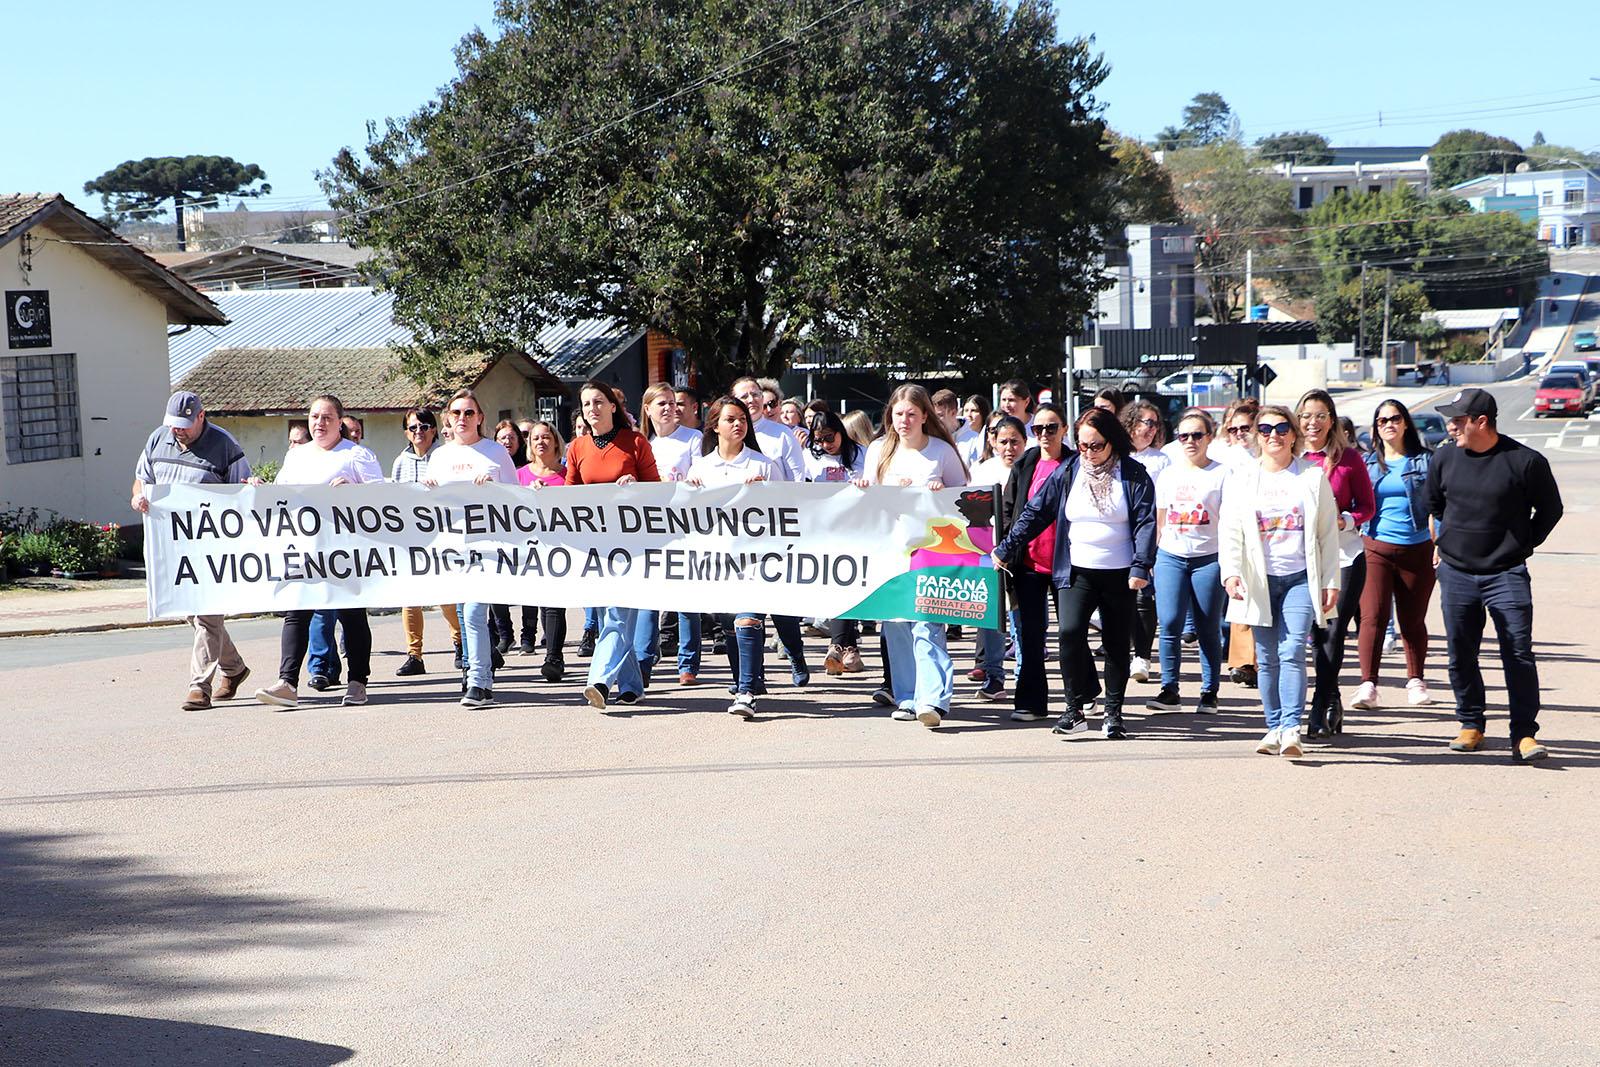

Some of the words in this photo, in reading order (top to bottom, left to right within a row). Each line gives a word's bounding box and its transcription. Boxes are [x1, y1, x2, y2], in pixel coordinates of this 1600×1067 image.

[170, 502, 244, 541] NÃO
[250, 499, 322, 537] VÃO
[331, 505, 405, 535] NOS
[412, 503, 607, 535] SILENCIAR!
[617, 505, 801, 538] DENUNCIE
[174, 555, 200, 586] A
[205, 543, 397, 584] VIOLÊNCIA!
[408, 546, 484, 576] DIGA
[496, 539, 572, 578] NÃO
[580, 547, 632, 578] AO
[916, 574, 988, 592] PARANÁ
[915, 585, 970, 601] UNIDO
[971, 591, 988, 603] NO
[917, 599, 966, 609] COMBATE
[969, 603, 985, 611] AO
